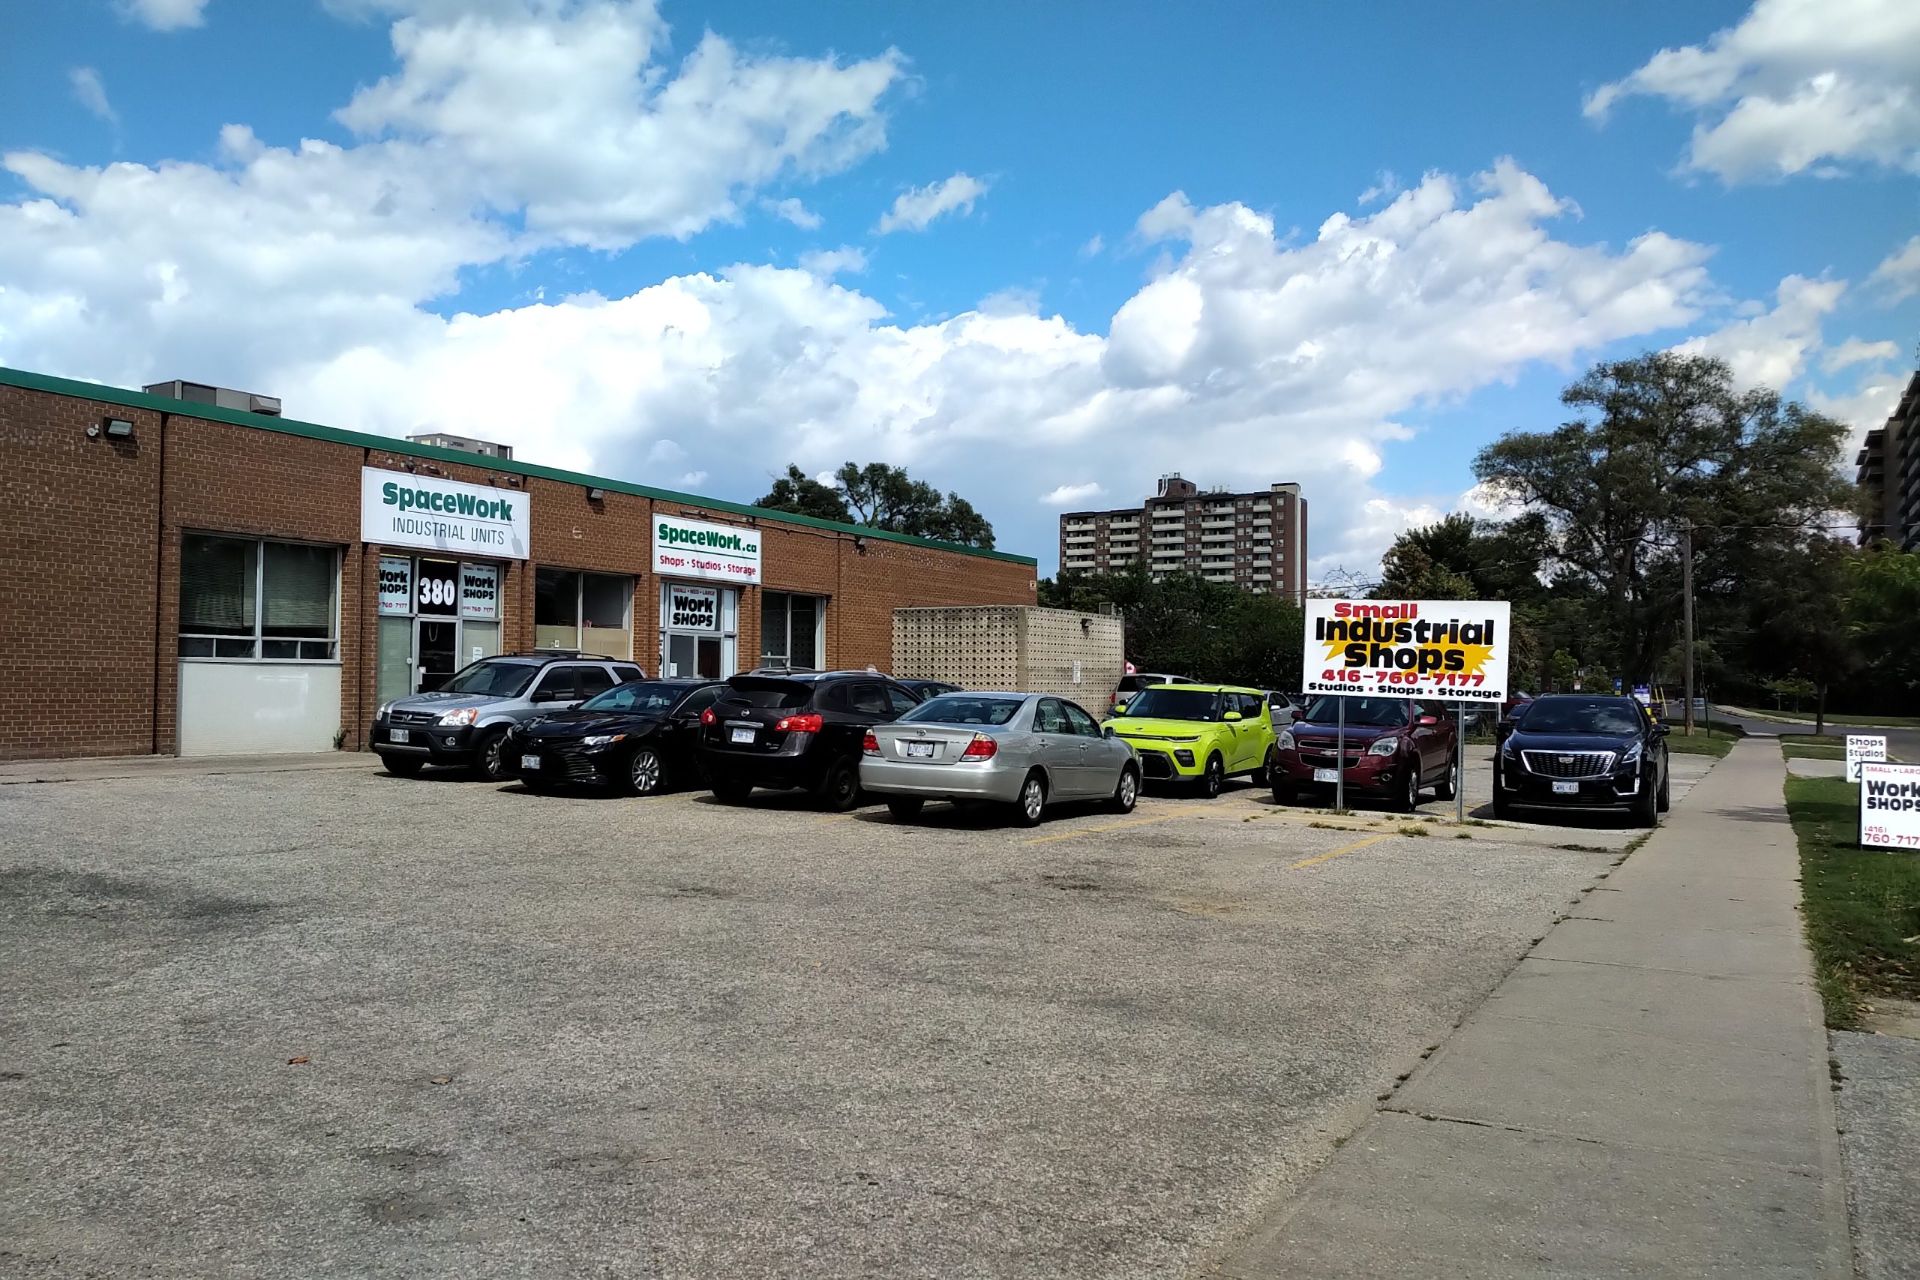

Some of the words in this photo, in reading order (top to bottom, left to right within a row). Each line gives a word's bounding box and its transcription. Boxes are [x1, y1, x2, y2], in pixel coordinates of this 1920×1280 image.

[392, 516, 466, 541] INDUSTRIAL
[470, 528, 505, 545] UNITS
[658, 523, 757, 553] SpaceWork.ca
[659, 555, 685, 567] Shops
[691, 559, 722, 571] Studios
[727, 563, 757, 576] Storage
[463, 574, 494, 589] Work
[419, 577, 456, 606] 380
[463, 588, 495, 600] SHOPS
[674, 595, 714, 613] Work
[1334, 602, 1418, 619] Small
[672, 612, 714, 627] SHOPS
[1315, 616, 1495, 646] Industrial
[1344, 642, 1465, 674] Shops
[1321, 669, 1485, 687] 416-760-7177
[1308, 682, 1364, 693] Studios
[1377, 685, 1424, 696] Shops
[1437, 687, 1502, 699] Storage
[1849, 737, 1884, 747] Shops
[1849, 749, 1885, 758] Studios
[1865, 766, 1891, 774] SMALL
[1866, 780, 1920, 798] Work
[1864, 825, 1887, 834] (416)
